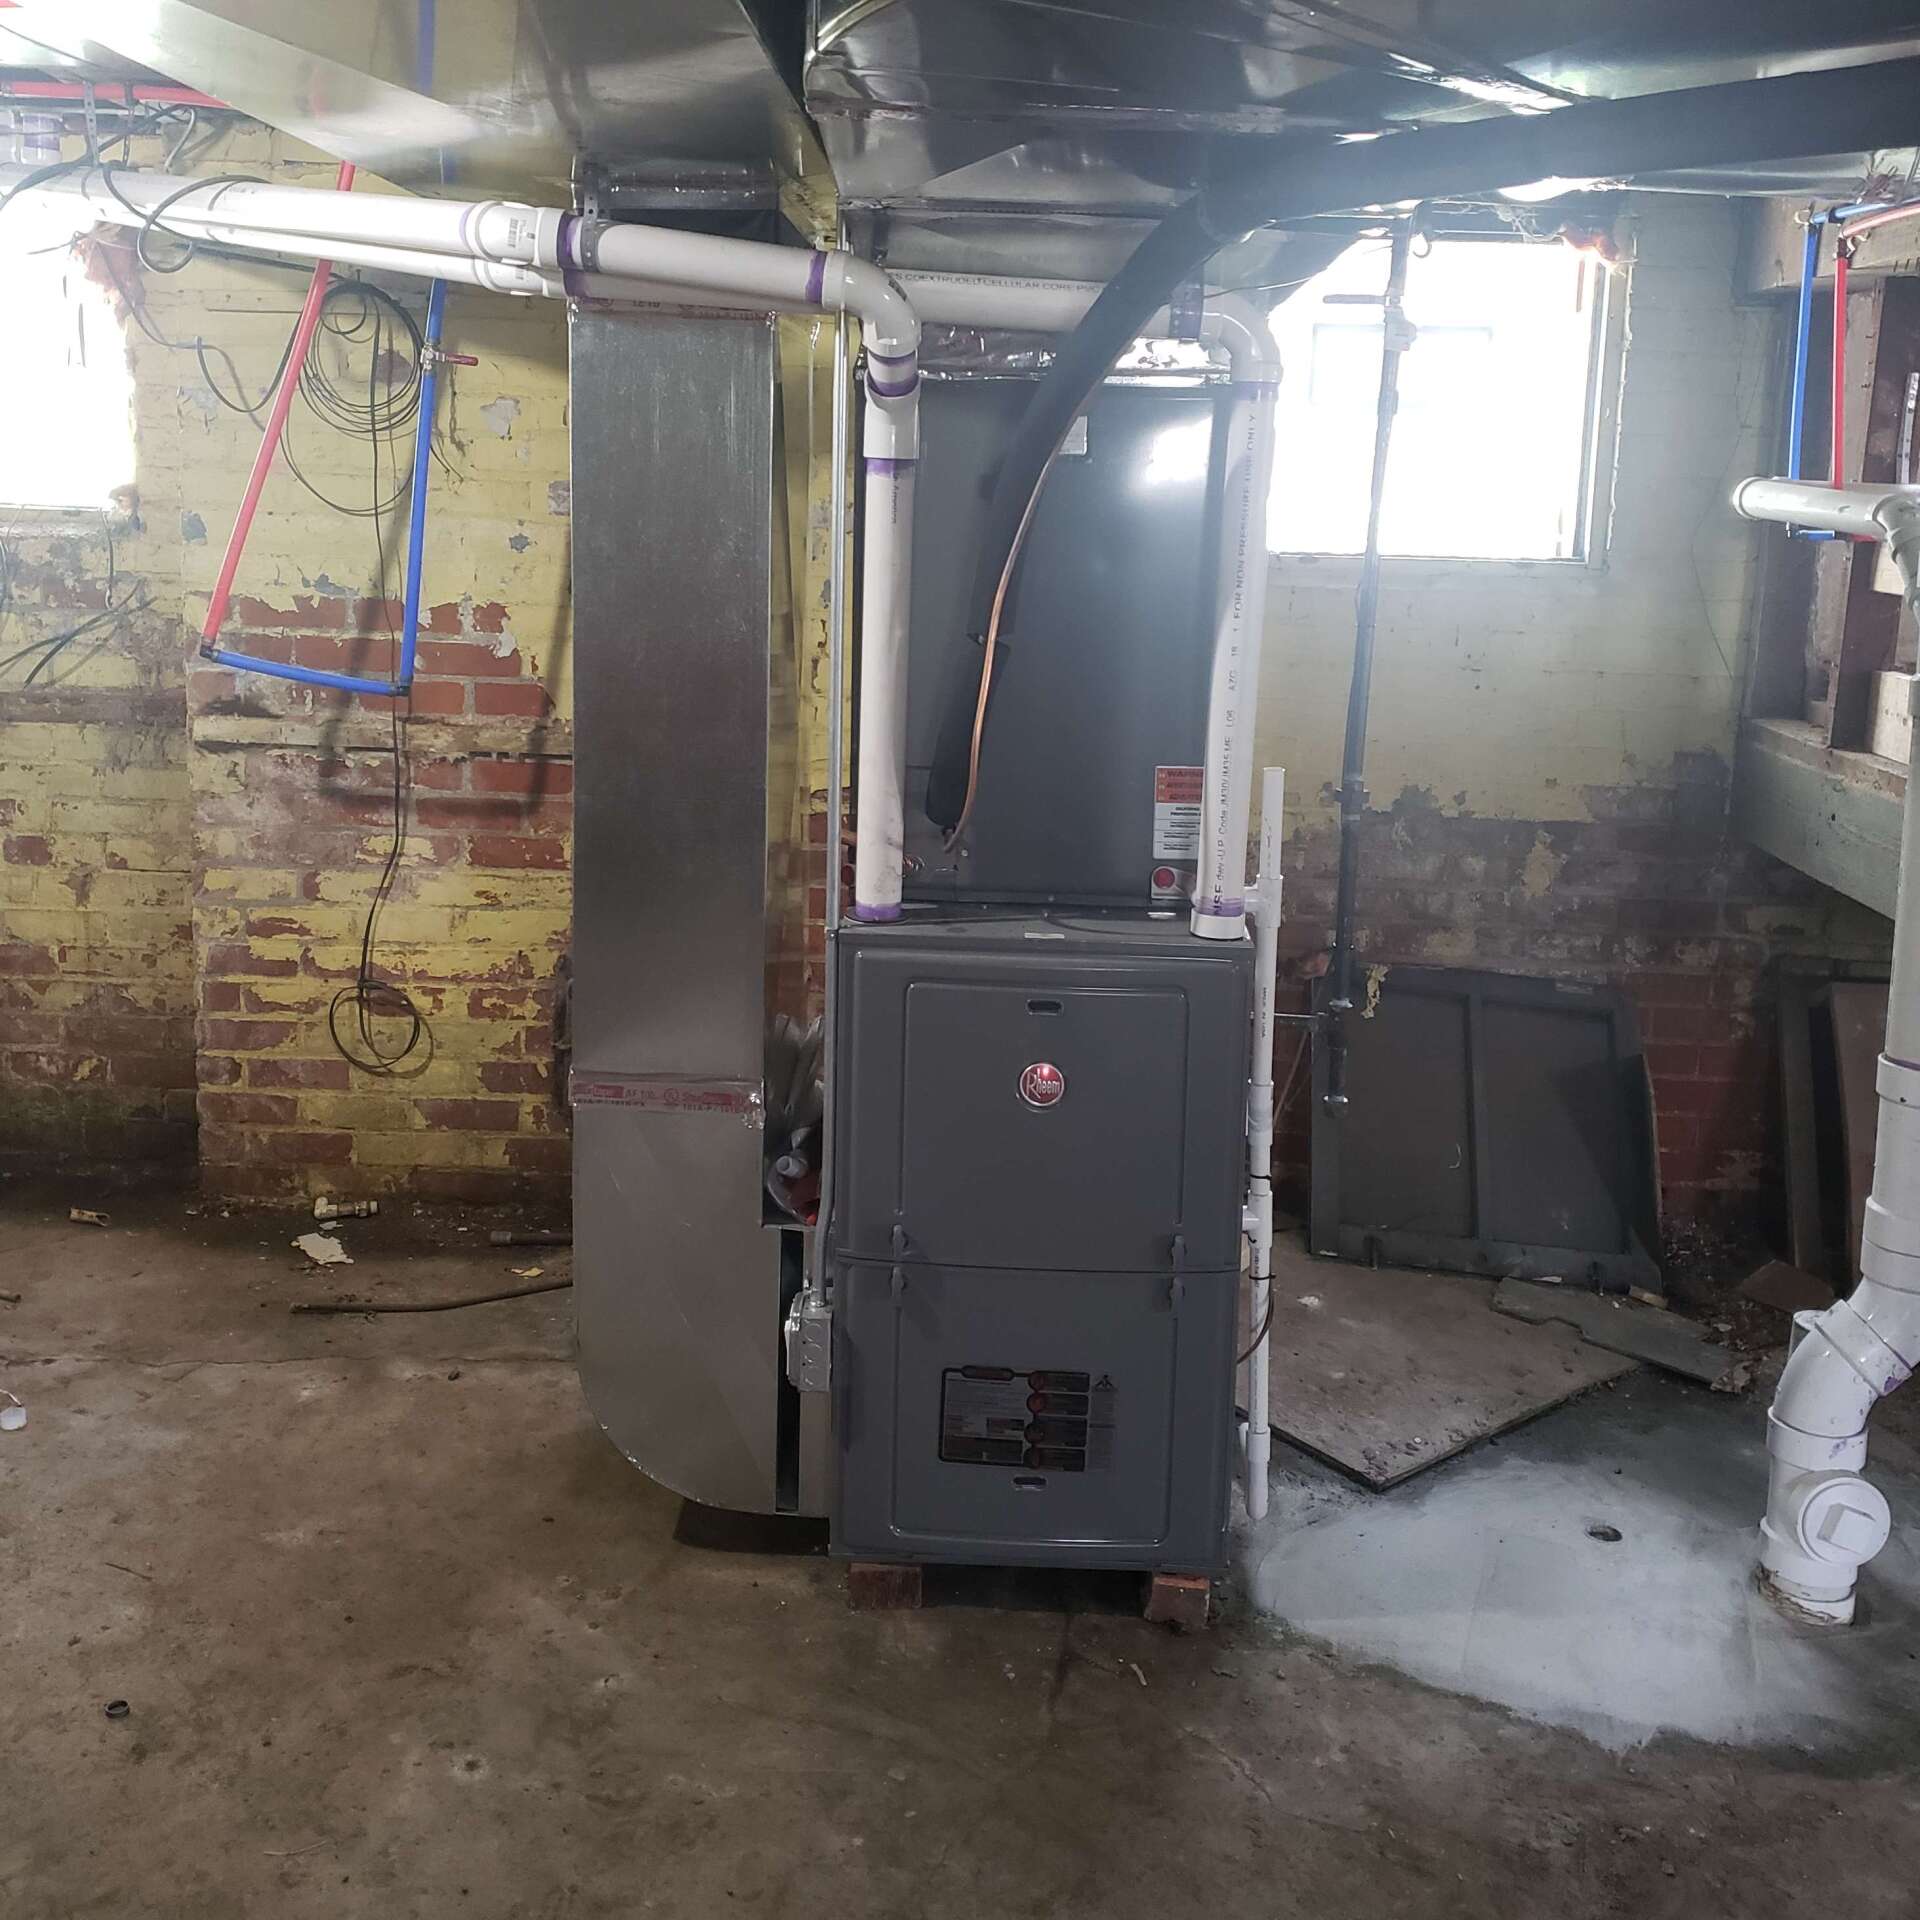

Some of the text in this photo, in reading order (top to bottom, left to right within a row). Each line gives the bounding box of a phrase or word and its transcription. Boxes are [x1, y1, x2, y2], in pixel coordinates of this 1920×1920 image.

[983, 278, 1039, 289] CELLULAR
[1233, 592, 1242, 619] FOR
[1246, 415, 1256, 450] ONLY
[1026, 1068, 1060, 1099] Rheem
